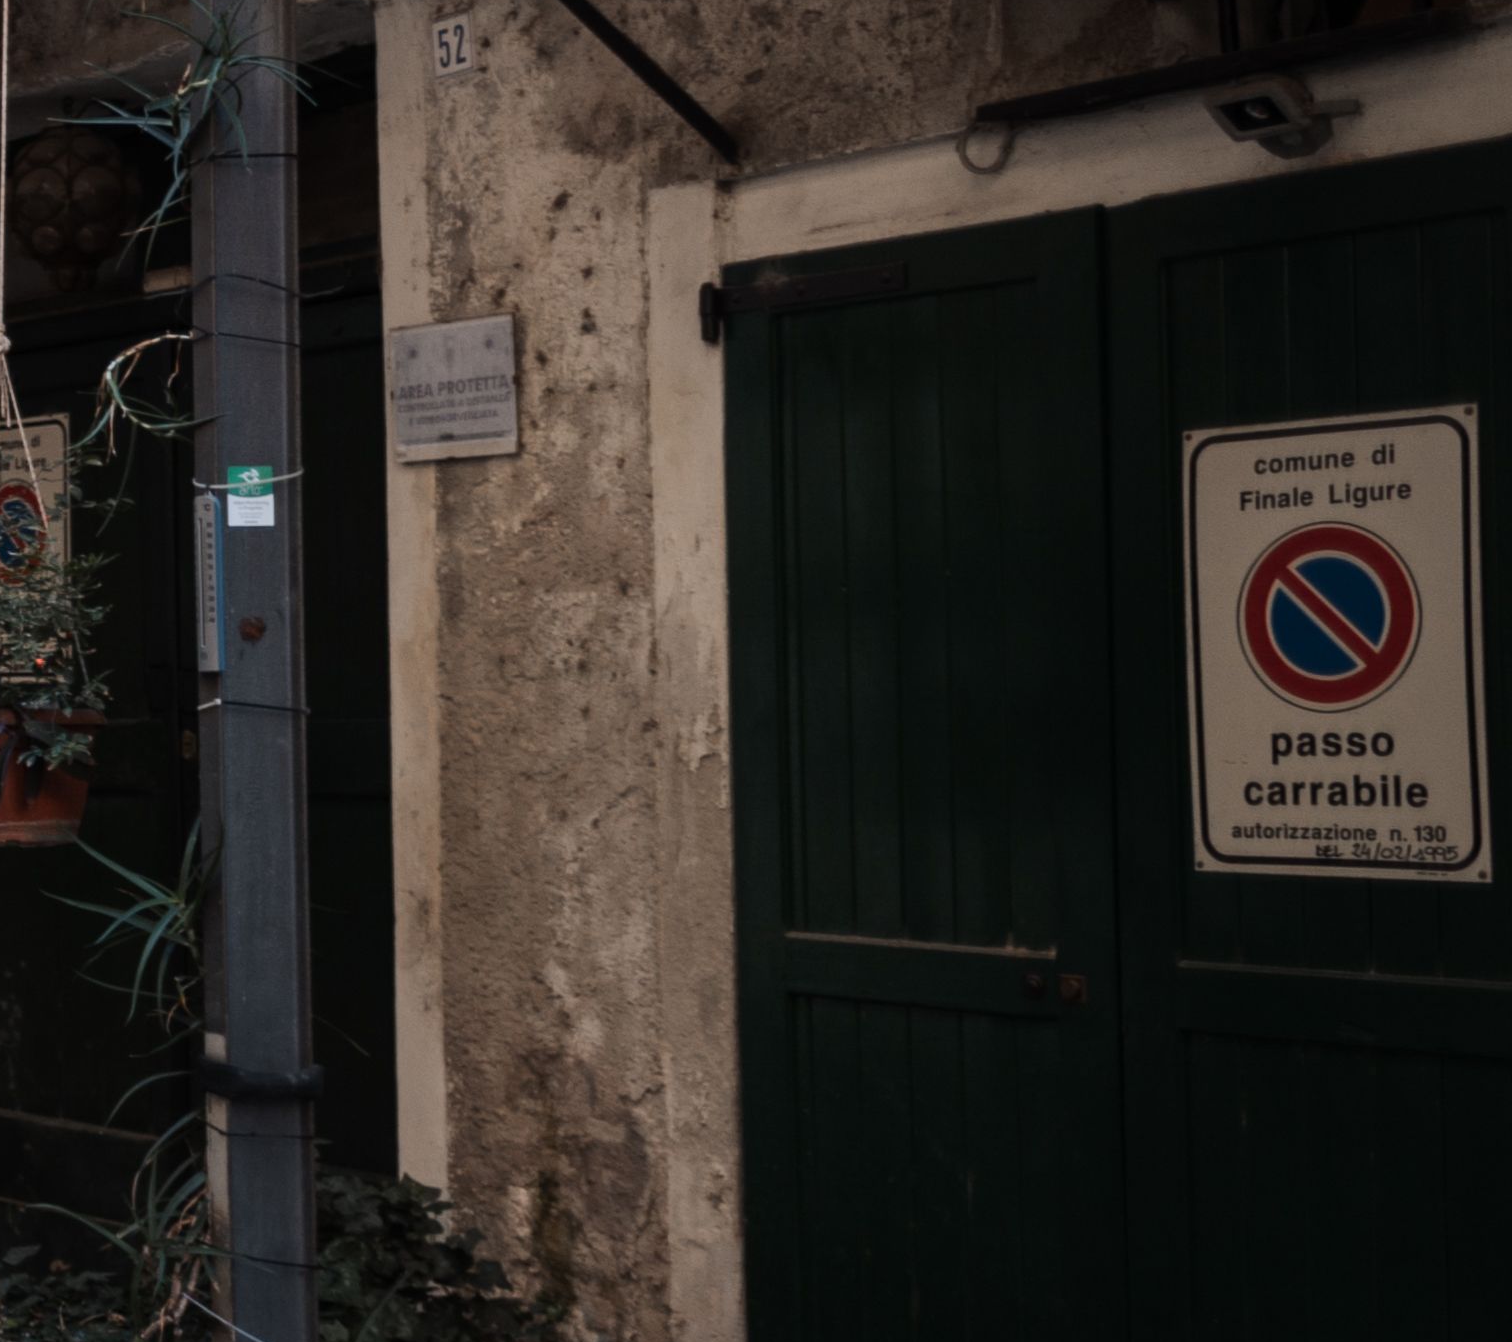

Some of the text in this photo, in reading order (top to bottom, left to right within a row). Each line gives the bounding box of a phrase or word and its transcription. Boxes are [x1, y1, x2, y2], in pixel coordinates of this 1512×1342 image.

[437, 24, 467, 69] 52
[398, 374, 509, 400] AREA PROTETTA
[1253, 443, 1396, 475] comune di
[1240, 482, 1412, 512] Finale Ligure
[1270, 731, 1395, 765] passo
[1243, 774, 1430, 809] carrabile
[1231, 823, 1447, 843] autorizzazione n. 130
[1315, 842, 1460, 862] DEL 24/02/1995
